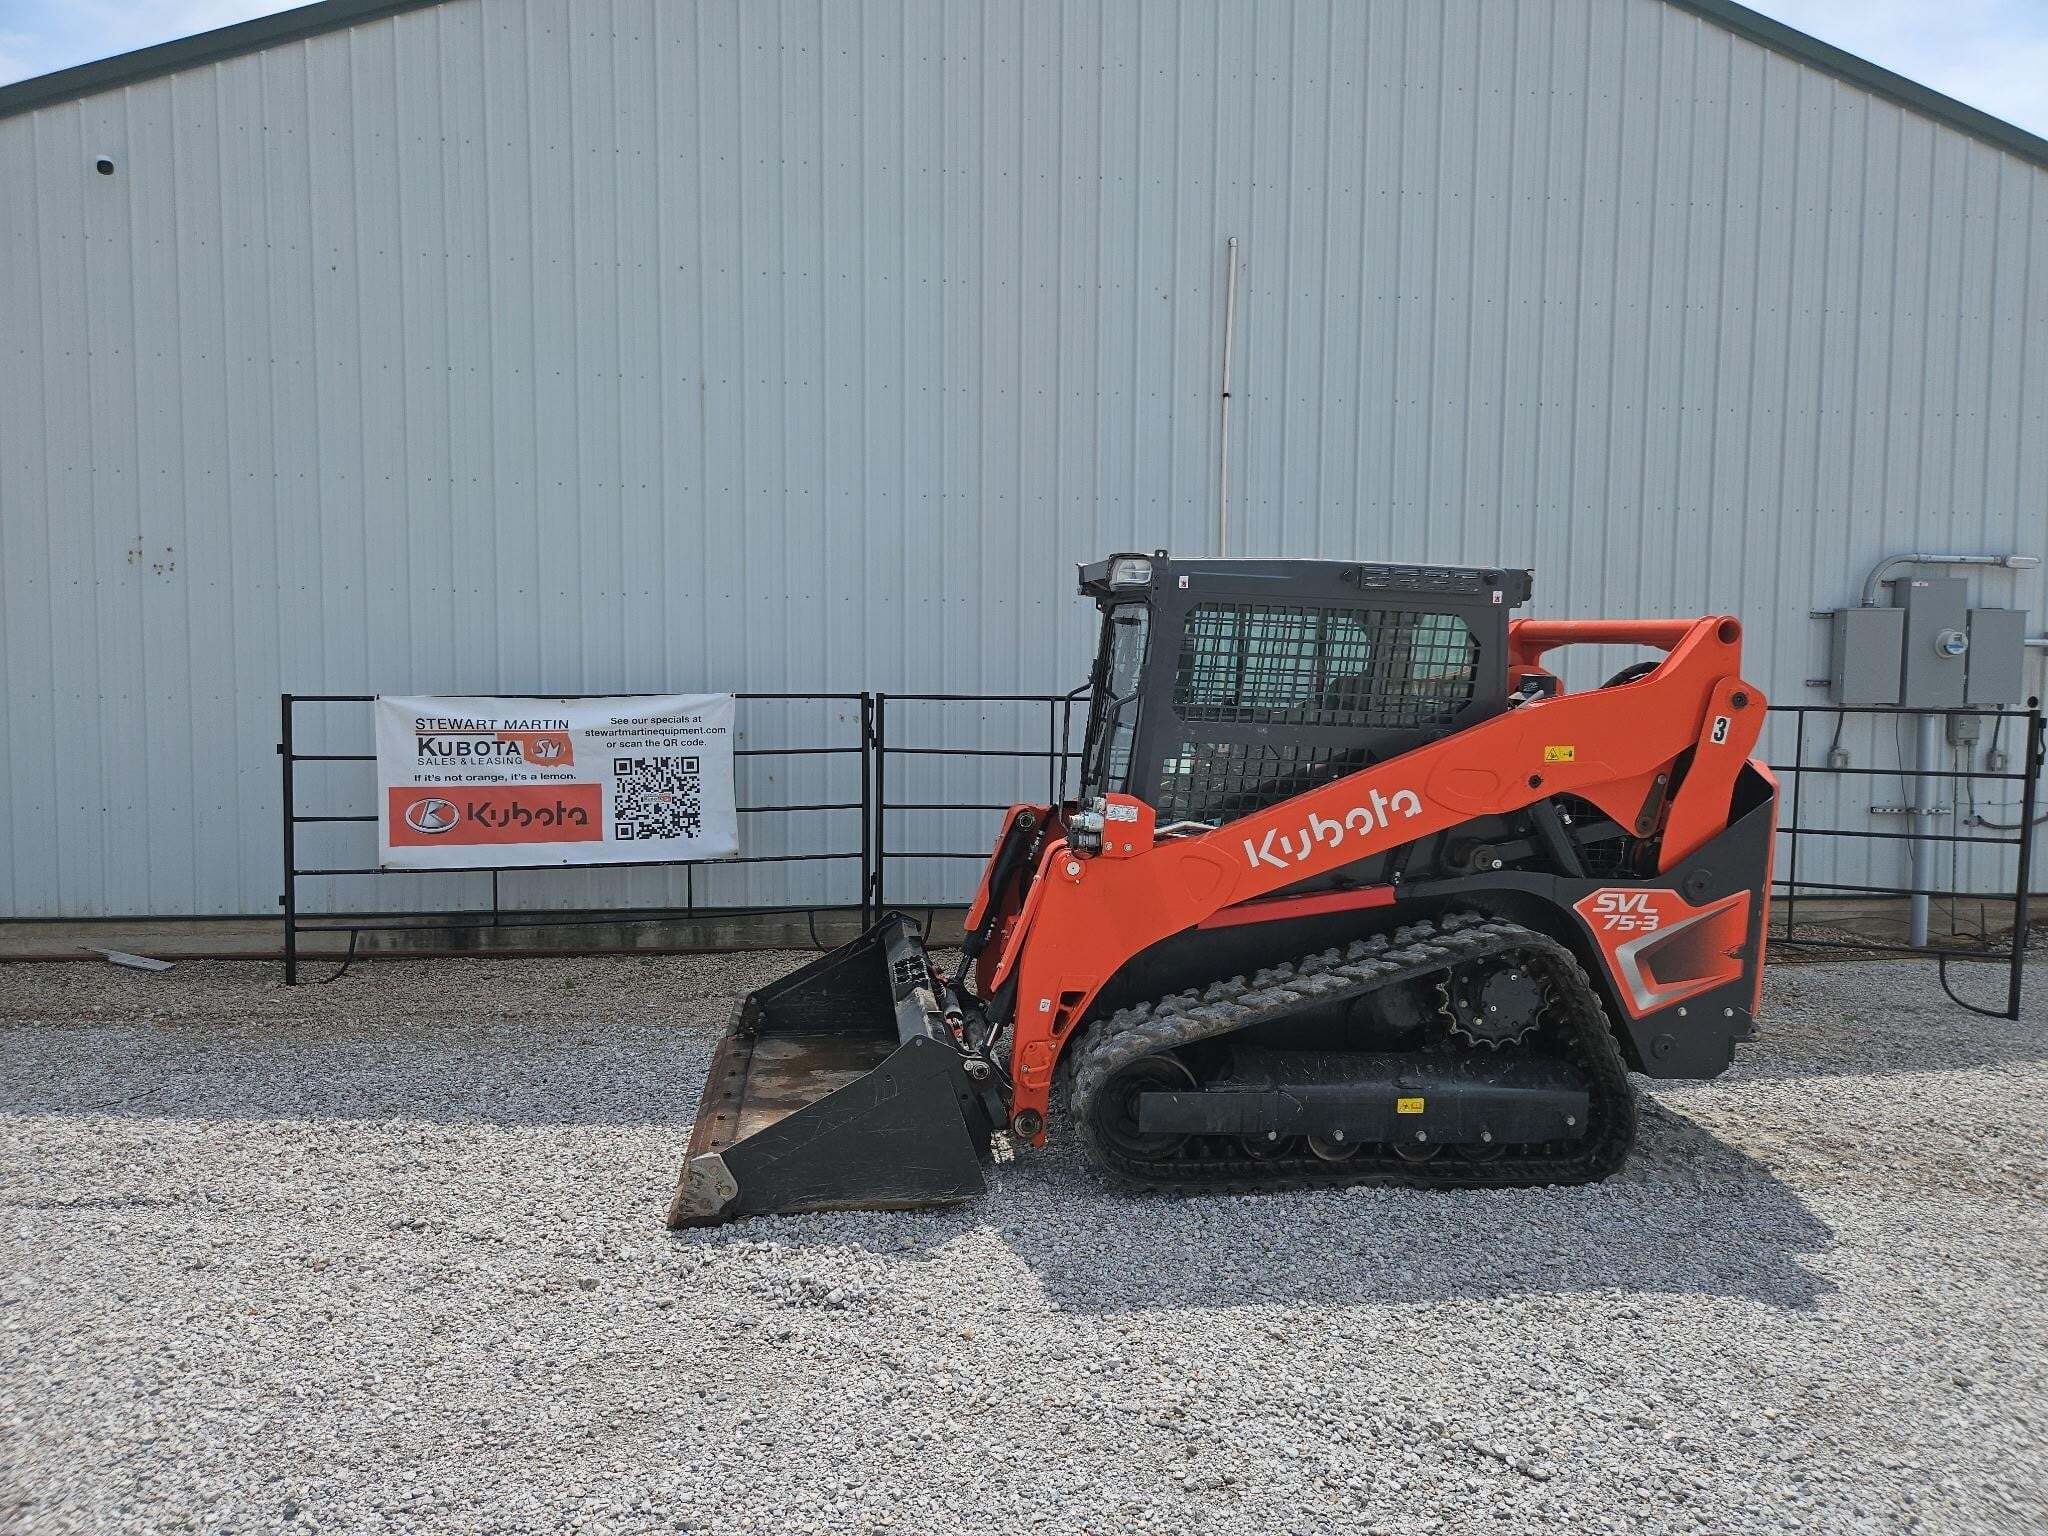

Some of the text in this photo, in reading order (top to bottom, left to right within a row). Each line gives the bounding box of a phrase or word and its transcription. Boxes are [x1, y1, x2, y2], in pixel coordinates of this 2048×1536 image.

[415, 718, 569, 730] STEWART MARTIN
[610, 715, 702, 726] See our specials at
[585, 726, 726, 738] stewartmartinequipment.com
[1712, 716, 1728, 742] 3
[606, 738, 707, 748] or scan the QR code.
[417, 757, 523, 766] SALES & LEASING
[414, 774, 421, 782] If
[424, 774, 441, 782] it's
[444, 774, 463, 782] not
[465, 775, 507, 783] orange,
[511, 773, 528, 781] it's
[540, 772, 577, 780] lemon.
[467, 800, 588, 828] Kubota
[1243, 785, 1424, 870] Kubota
[1592, 892, 1658, 913] SVL
[1603, 914, 1659, 931] 75-3
